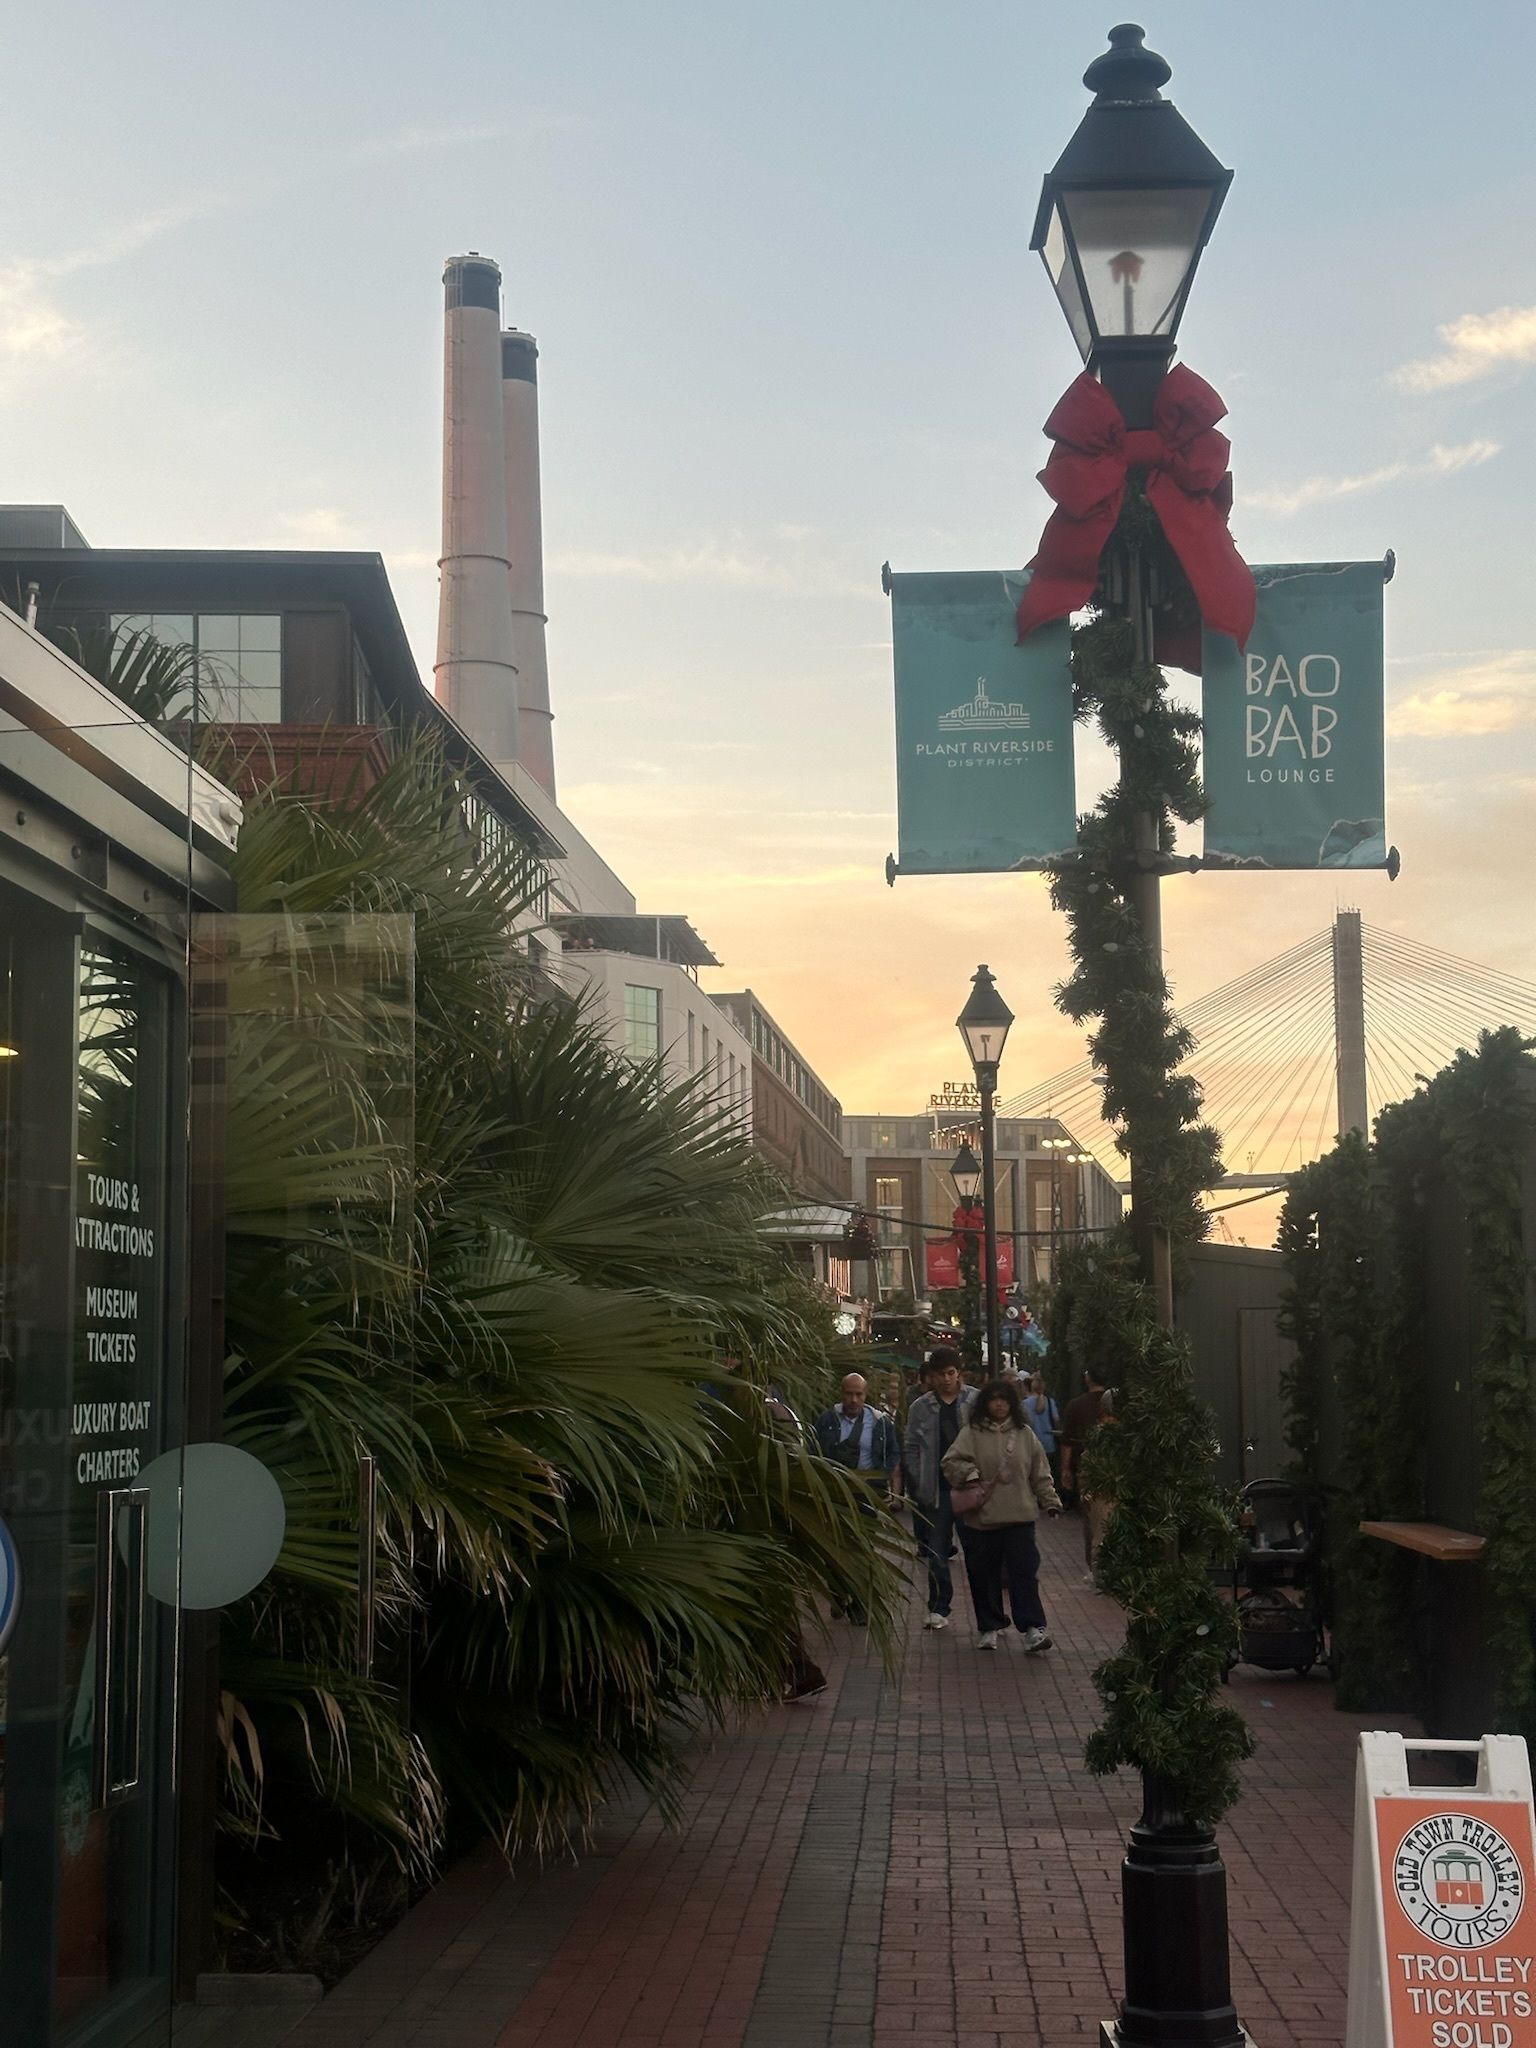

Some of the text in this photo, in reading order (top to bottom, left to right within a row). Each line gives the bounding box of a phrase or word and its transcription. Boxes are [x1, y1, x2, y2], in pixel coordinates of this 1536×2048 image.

[1246, 653, 1340, 697] BAO
[916, 740, 1054, 755] PLANT RIVERSIDE
[1246, 704, 1338, 759] BAB
[1247, 769, 1335, 783] LOUNGE
[930, 1094, 1002, 1107] RIVERSE
[943, 1082, 980, 1094] PLAN
[87, 1173, 140, 1213] TOURS &
[86, 1286, 138, 1319] MUSEUM
[86, 1332, 136, 1363] TICKETS
[71, 1402, 117, 1435] UXURY
[119, 1401, 151, 1431] BOAT
[77, 1447, 140, 1484] CHARTERS
[1398, 1818, 1520, 1896] OLD TOWN TROLLEY
[1418, 1902, 1508, 1946] TOURS
[1397, 1954, 1533, 1984] TROLLEY
[1406, 1986, 1532, 2017] TICKETS
[1432, 2020, 1513, 2048] SOLD
